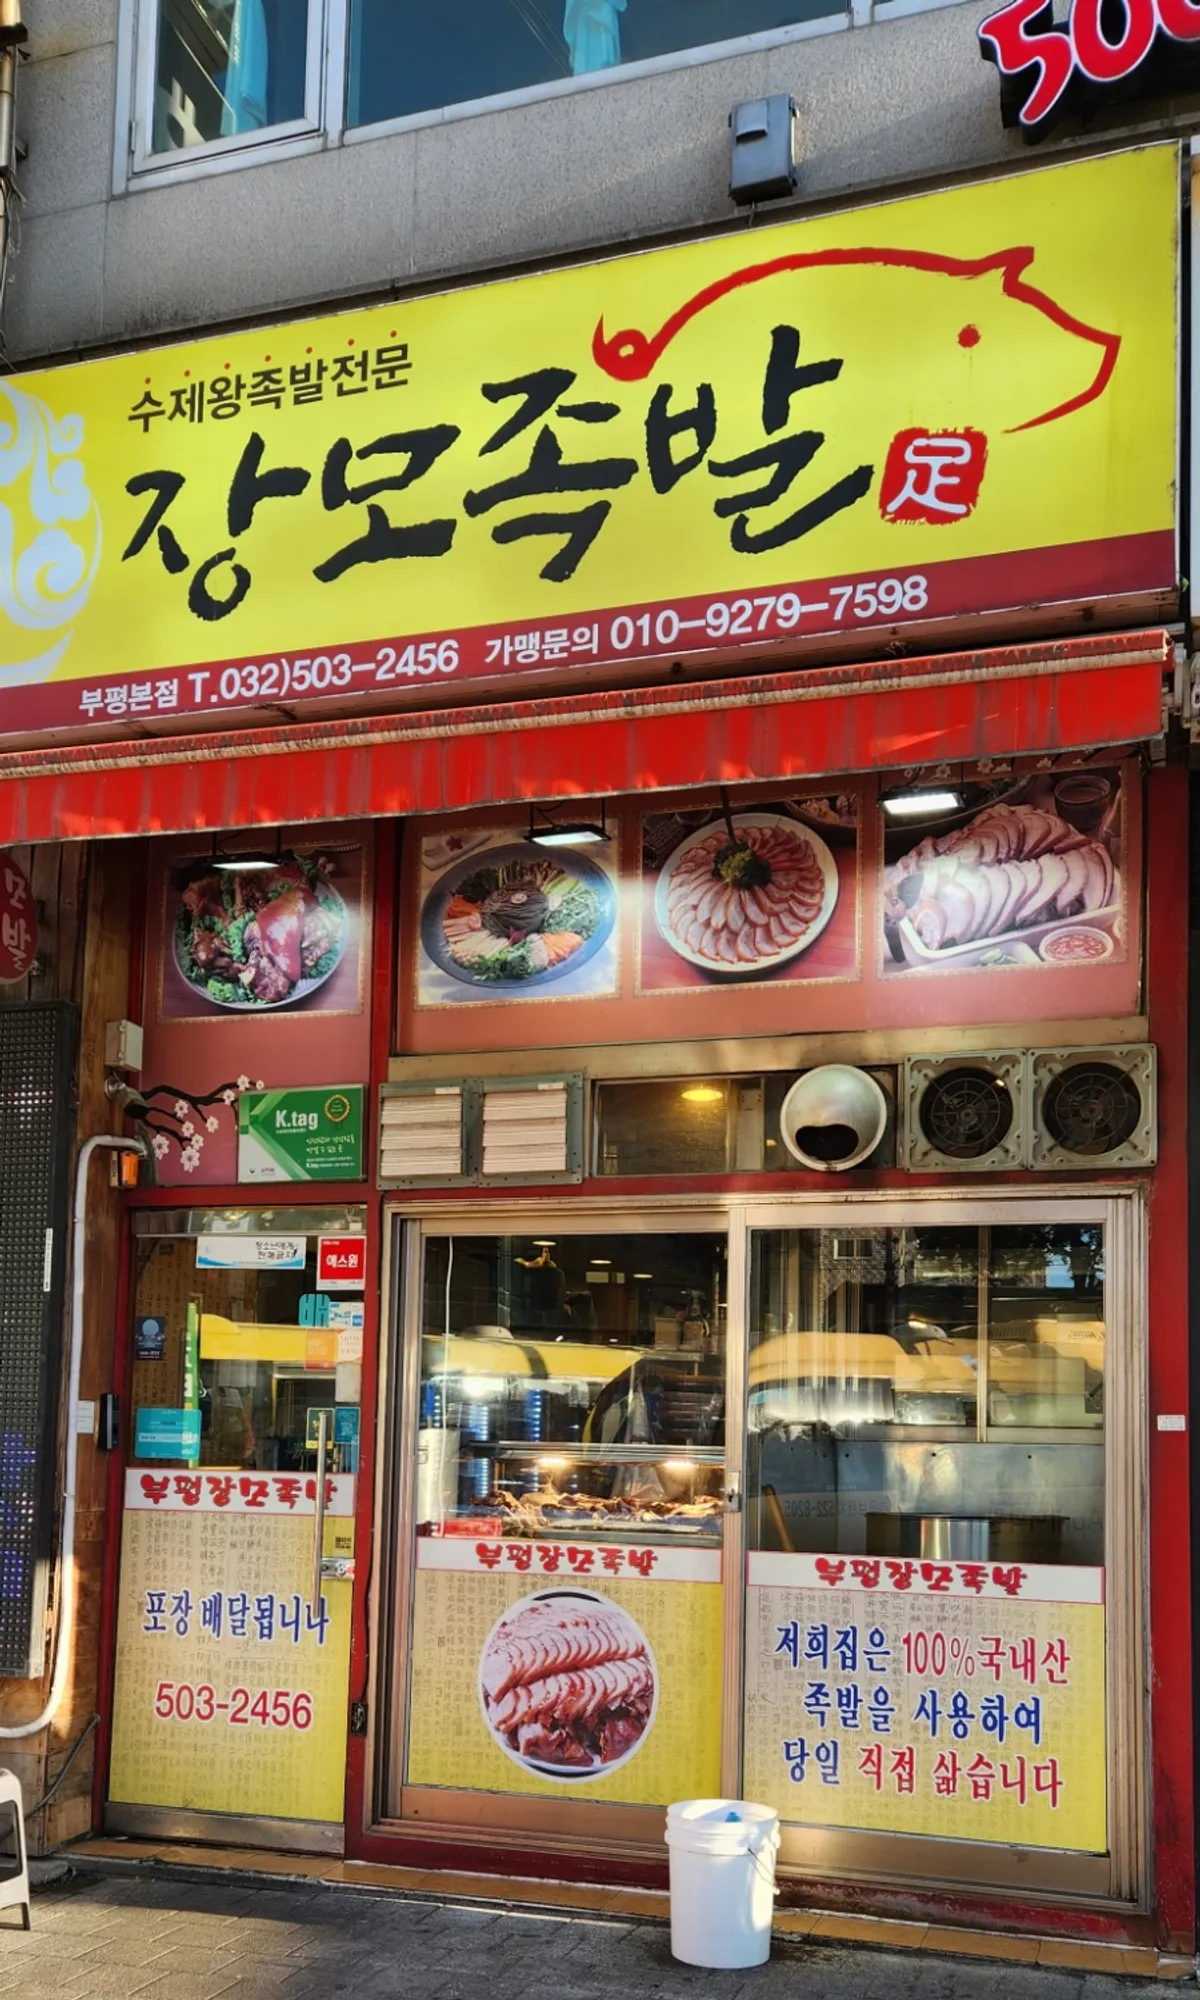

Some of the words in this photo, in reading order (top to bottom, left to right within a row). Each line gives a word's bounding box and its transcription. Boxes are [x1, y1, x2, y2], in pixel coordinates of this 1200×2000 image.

[128, 343, 413, 433] 수제왕족발전문
[122, 324, 874, 621] 장모족발
[886, 437, 973, 514] 足
[79, 682, 179, 717] 부평본점
[484, 624, 599, 666] 가맹문의
[610, 575, 929, 650] 010-9279-7598
[275, 1109, 319, 1131] K.tag
[140, 1474, 338, 1510] 부평장모족발
[475, 1542, 658, 1576] 부평장모족발
[814, 1557, 1028, 1596] 부평장모족발
[144, 1590, 193, 1637] 포장
[774, 1621, 891, 1674] 저희집은
[902, 1630, 1071, 1685] 100%국내산
[155, 1683, 313, 1729] 503-2456
[803, 1681, 896, 1733] 족발을
[912, 1689, 1042, 1745] 사용하여
[783, 1738, 841, 1785] 당일
[858, 1744, 915, 1794] 직접
[933, 1752, 1063, 1807] 삶습니다
